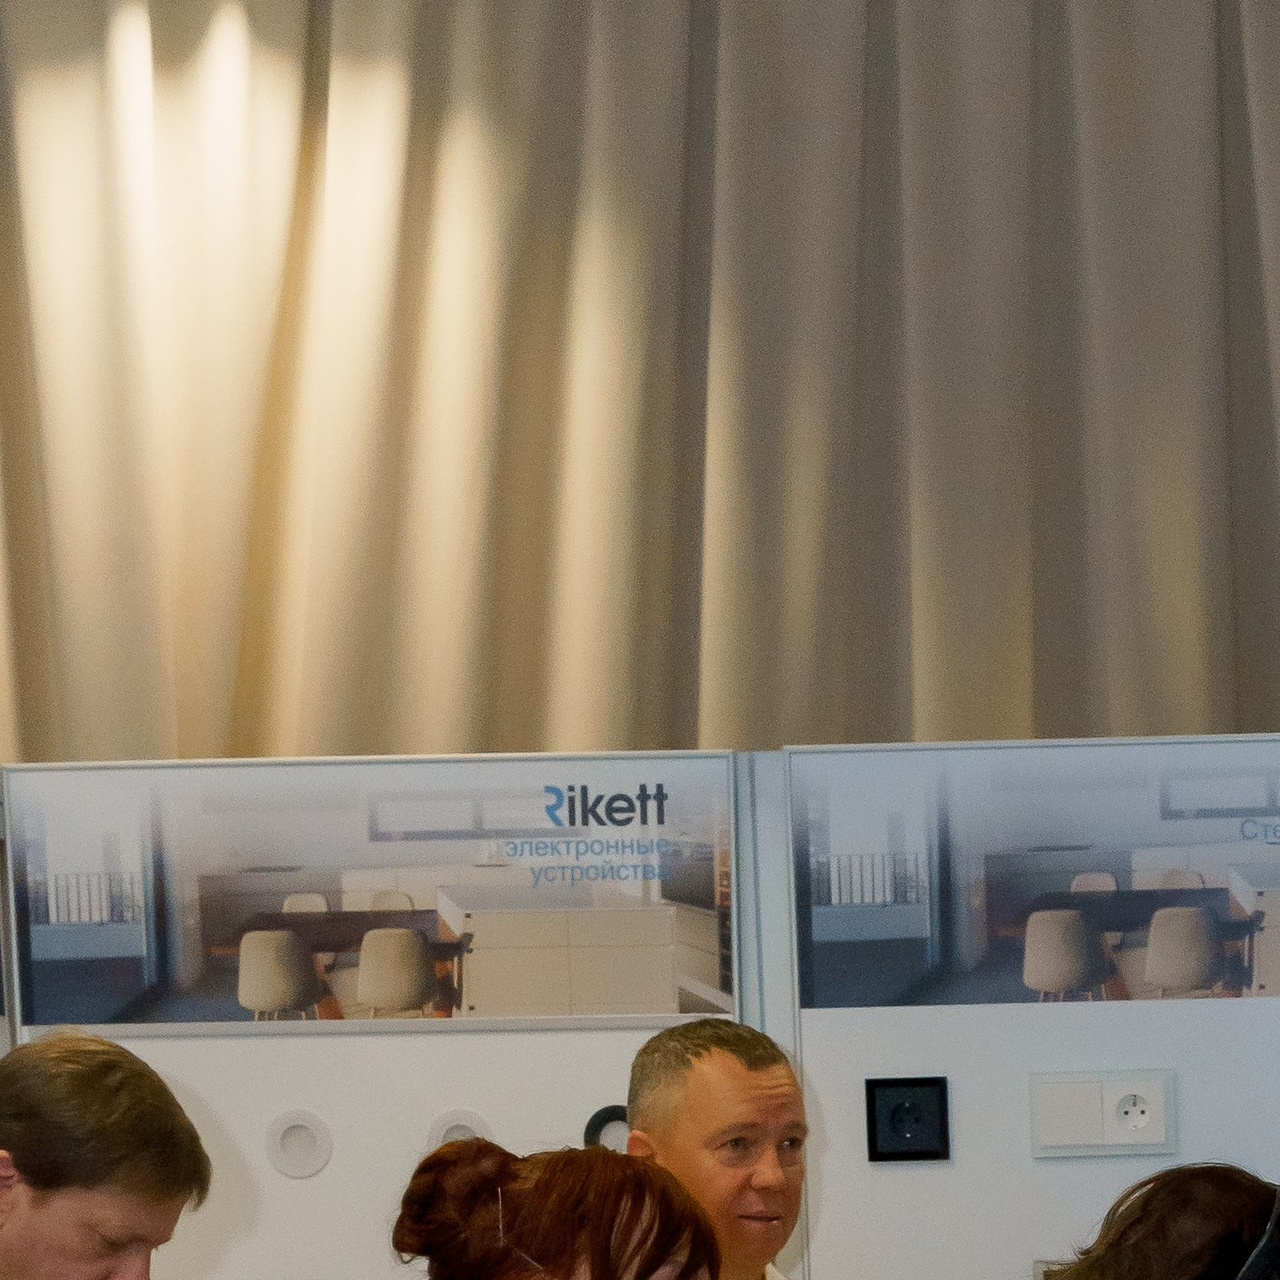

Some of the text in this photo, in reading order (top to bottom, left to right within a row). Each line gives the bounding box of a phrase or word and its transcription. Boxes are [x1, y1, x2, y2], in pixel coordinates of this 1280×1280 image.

[543, 782, 669, 828] Rikett
[504, 837, 672, 862] электронные
[530, 859, 672, 889] устройства
